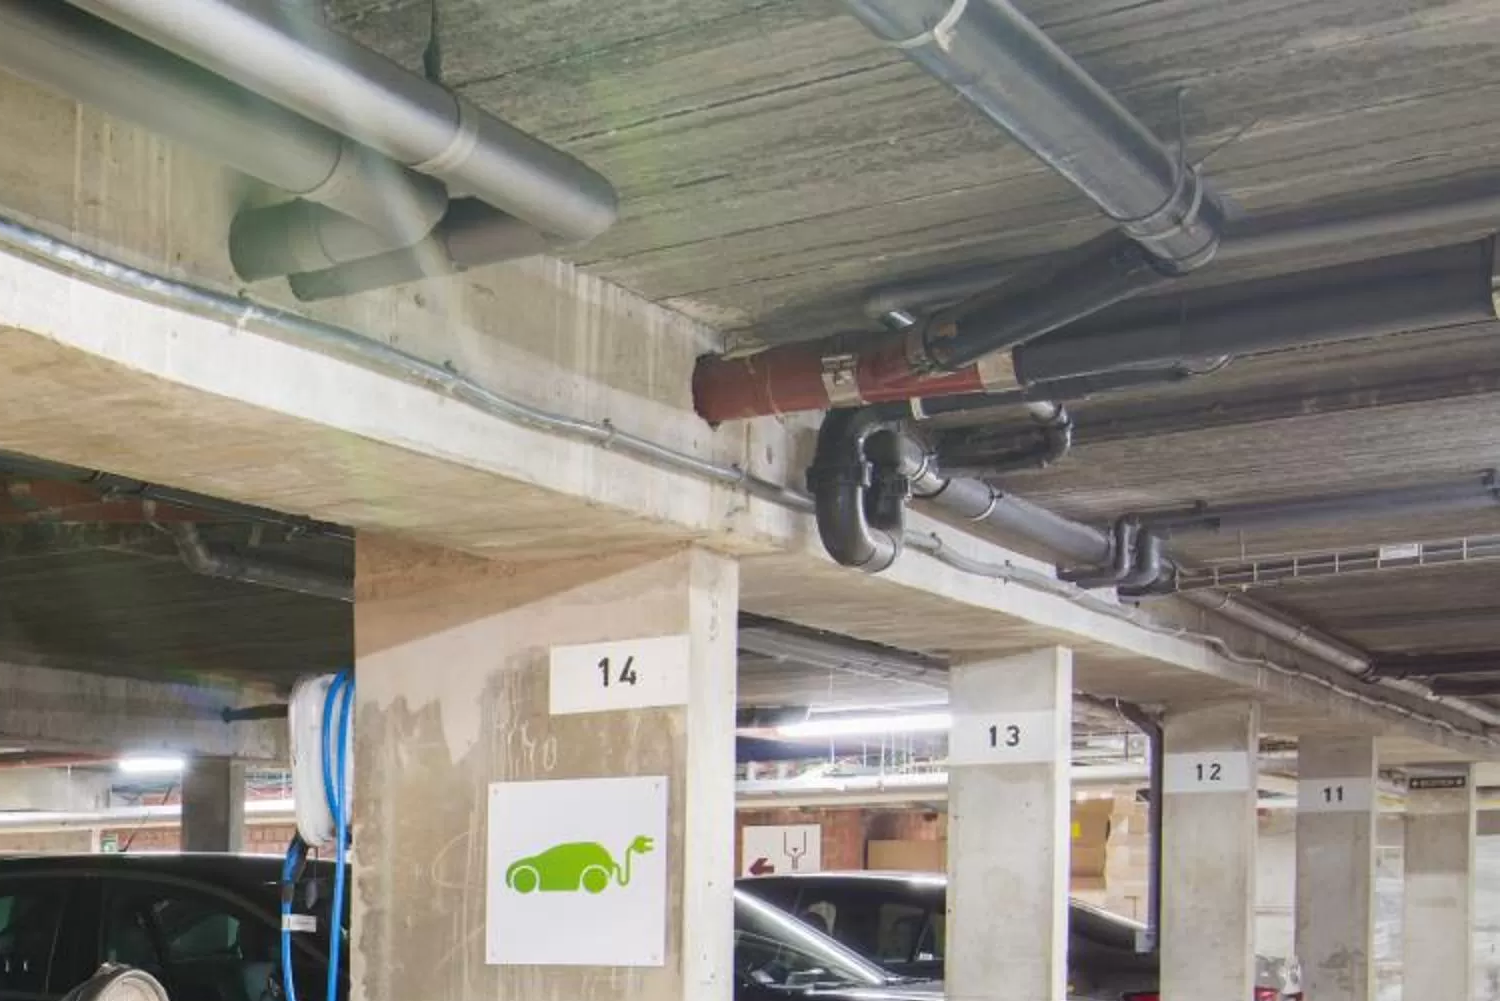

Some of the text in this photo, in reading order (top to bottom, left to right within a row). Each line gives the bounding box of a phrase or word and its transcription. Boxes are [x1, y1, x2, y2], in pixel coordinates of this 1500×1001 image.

[598, 656, 637, 687] 14
[989, 725, 1020, 747] 13
[1196, 763, 1221, 781] 12
[1324, 785, 1344, 802] 11
